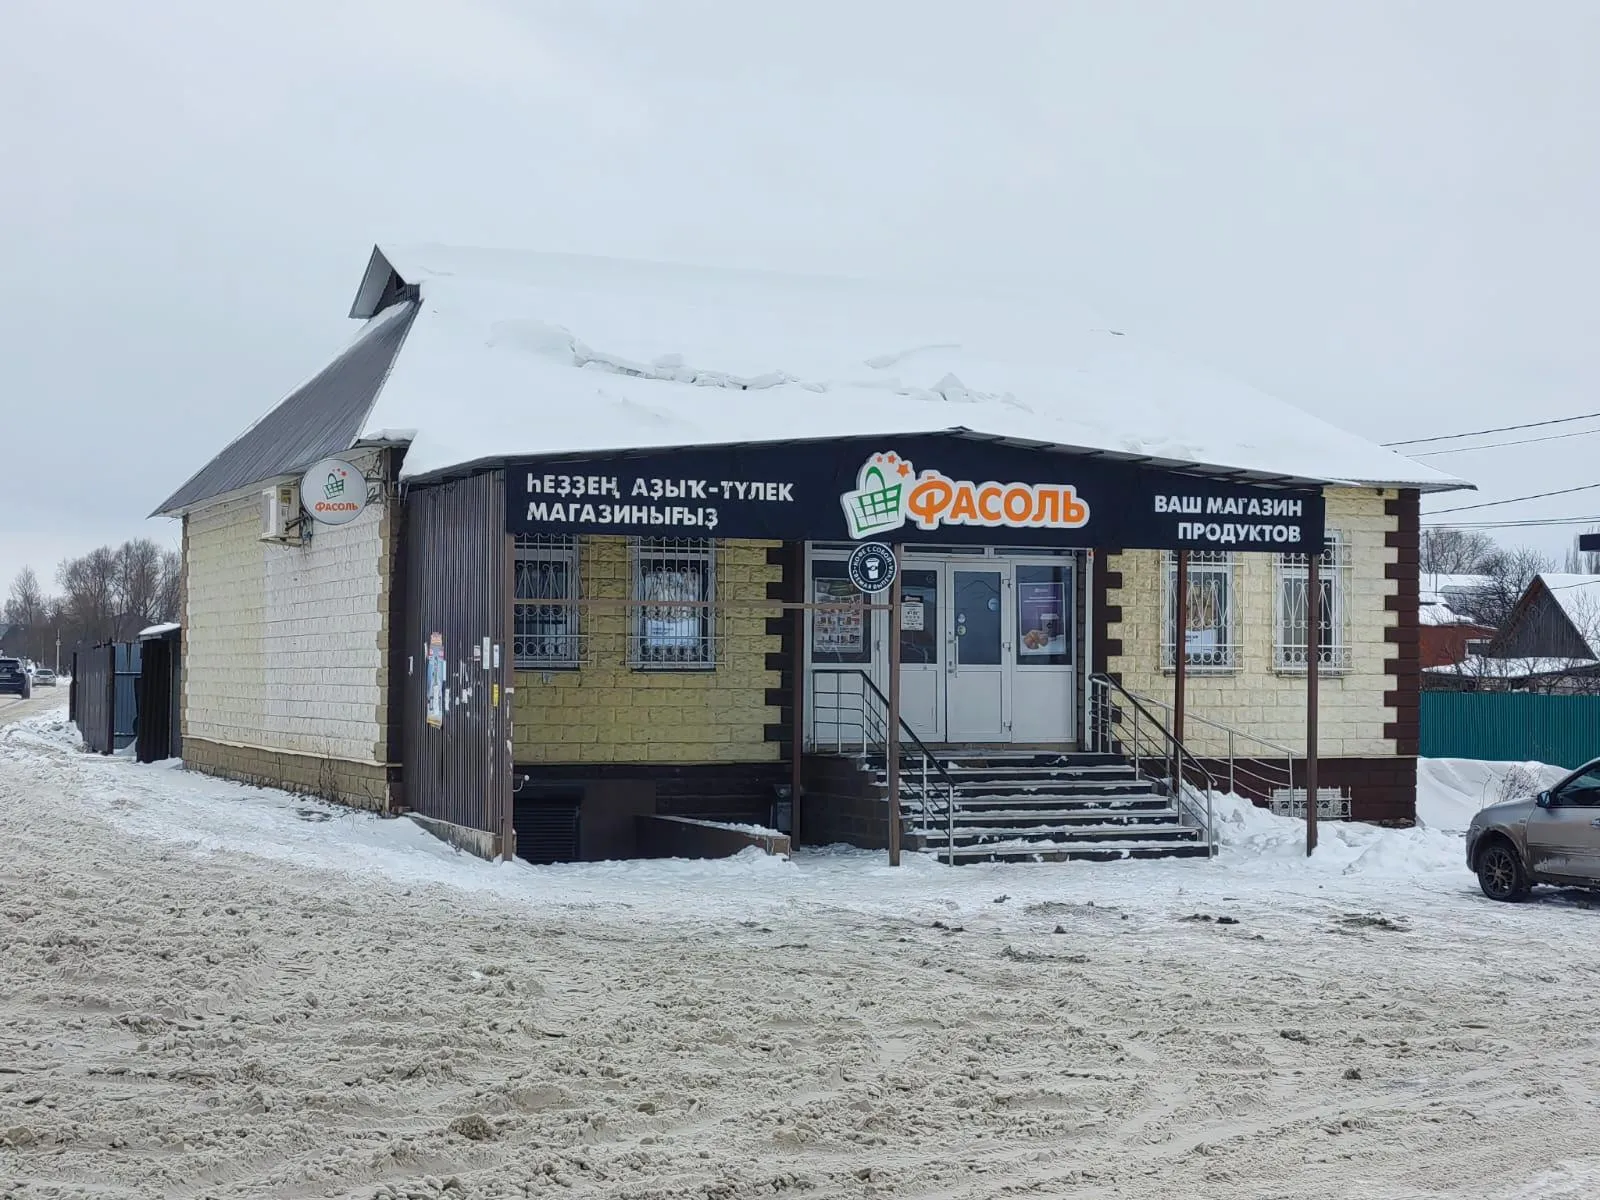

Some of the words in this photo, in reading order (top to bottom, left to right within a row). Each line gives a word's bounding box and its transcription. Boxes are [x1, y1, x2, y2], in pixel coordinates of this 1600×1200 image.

[314, 501, 359, 512] ФАСОЛЬ
[908, 475, 1086, 525] ФАСОЛЬ
[1154, 495, 1201, 514] ВАШ
[1206, 497, 1302, 517] МАГАЗИН
[526, 501, 719, 531] МАГАЗИНЫҒЫҘ
[1178, 522, 1301, 544] ПРОДУКТОВ
[853, 548, 867, 567] КОФЕ
[872, 546, 893, 563] СОБОЙ
[852, 569, 872, 590] СВЕЖАЯ
